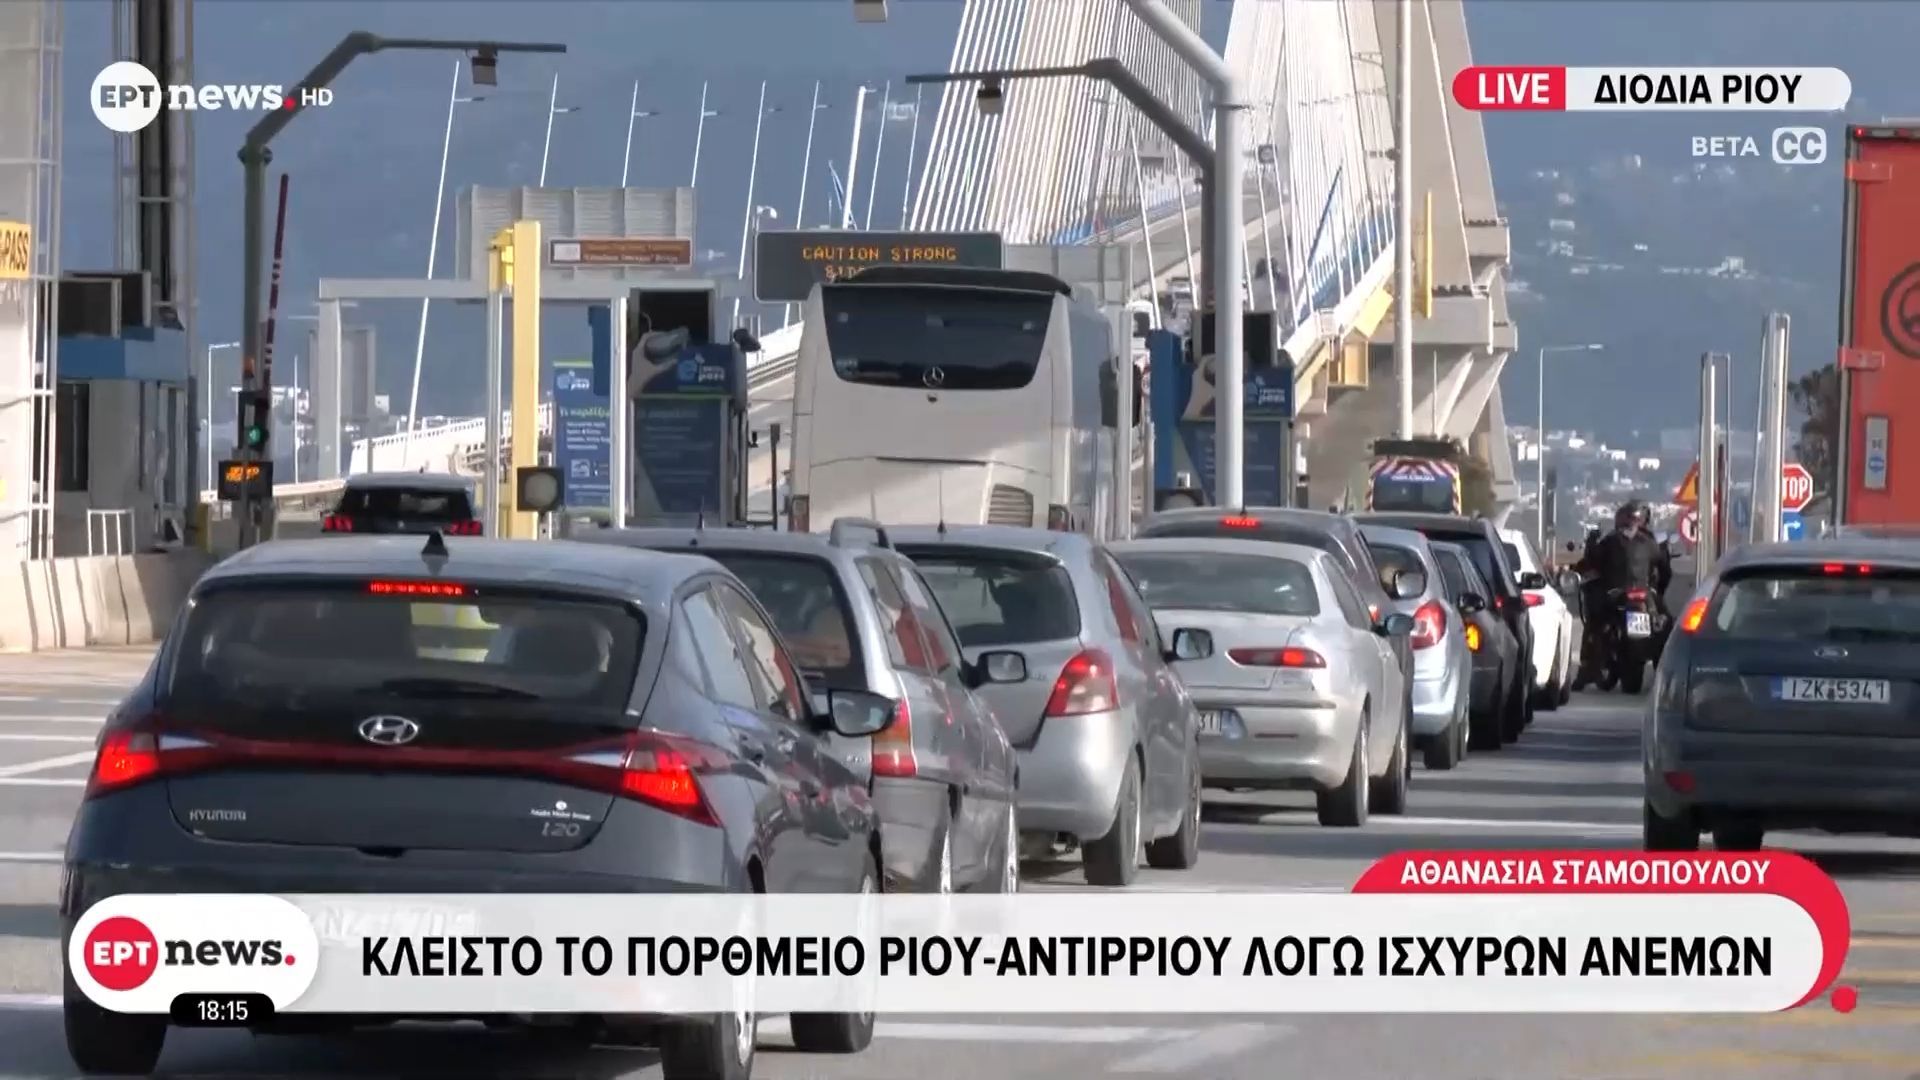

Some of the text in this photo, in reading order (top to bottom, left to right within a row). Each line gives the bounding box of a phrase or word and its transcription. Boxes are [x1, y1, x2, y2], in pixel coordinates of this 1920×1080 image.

[802, 246, 957, 261] CAUTION STRONG
[1782, 476, 1808, 500] TOP
